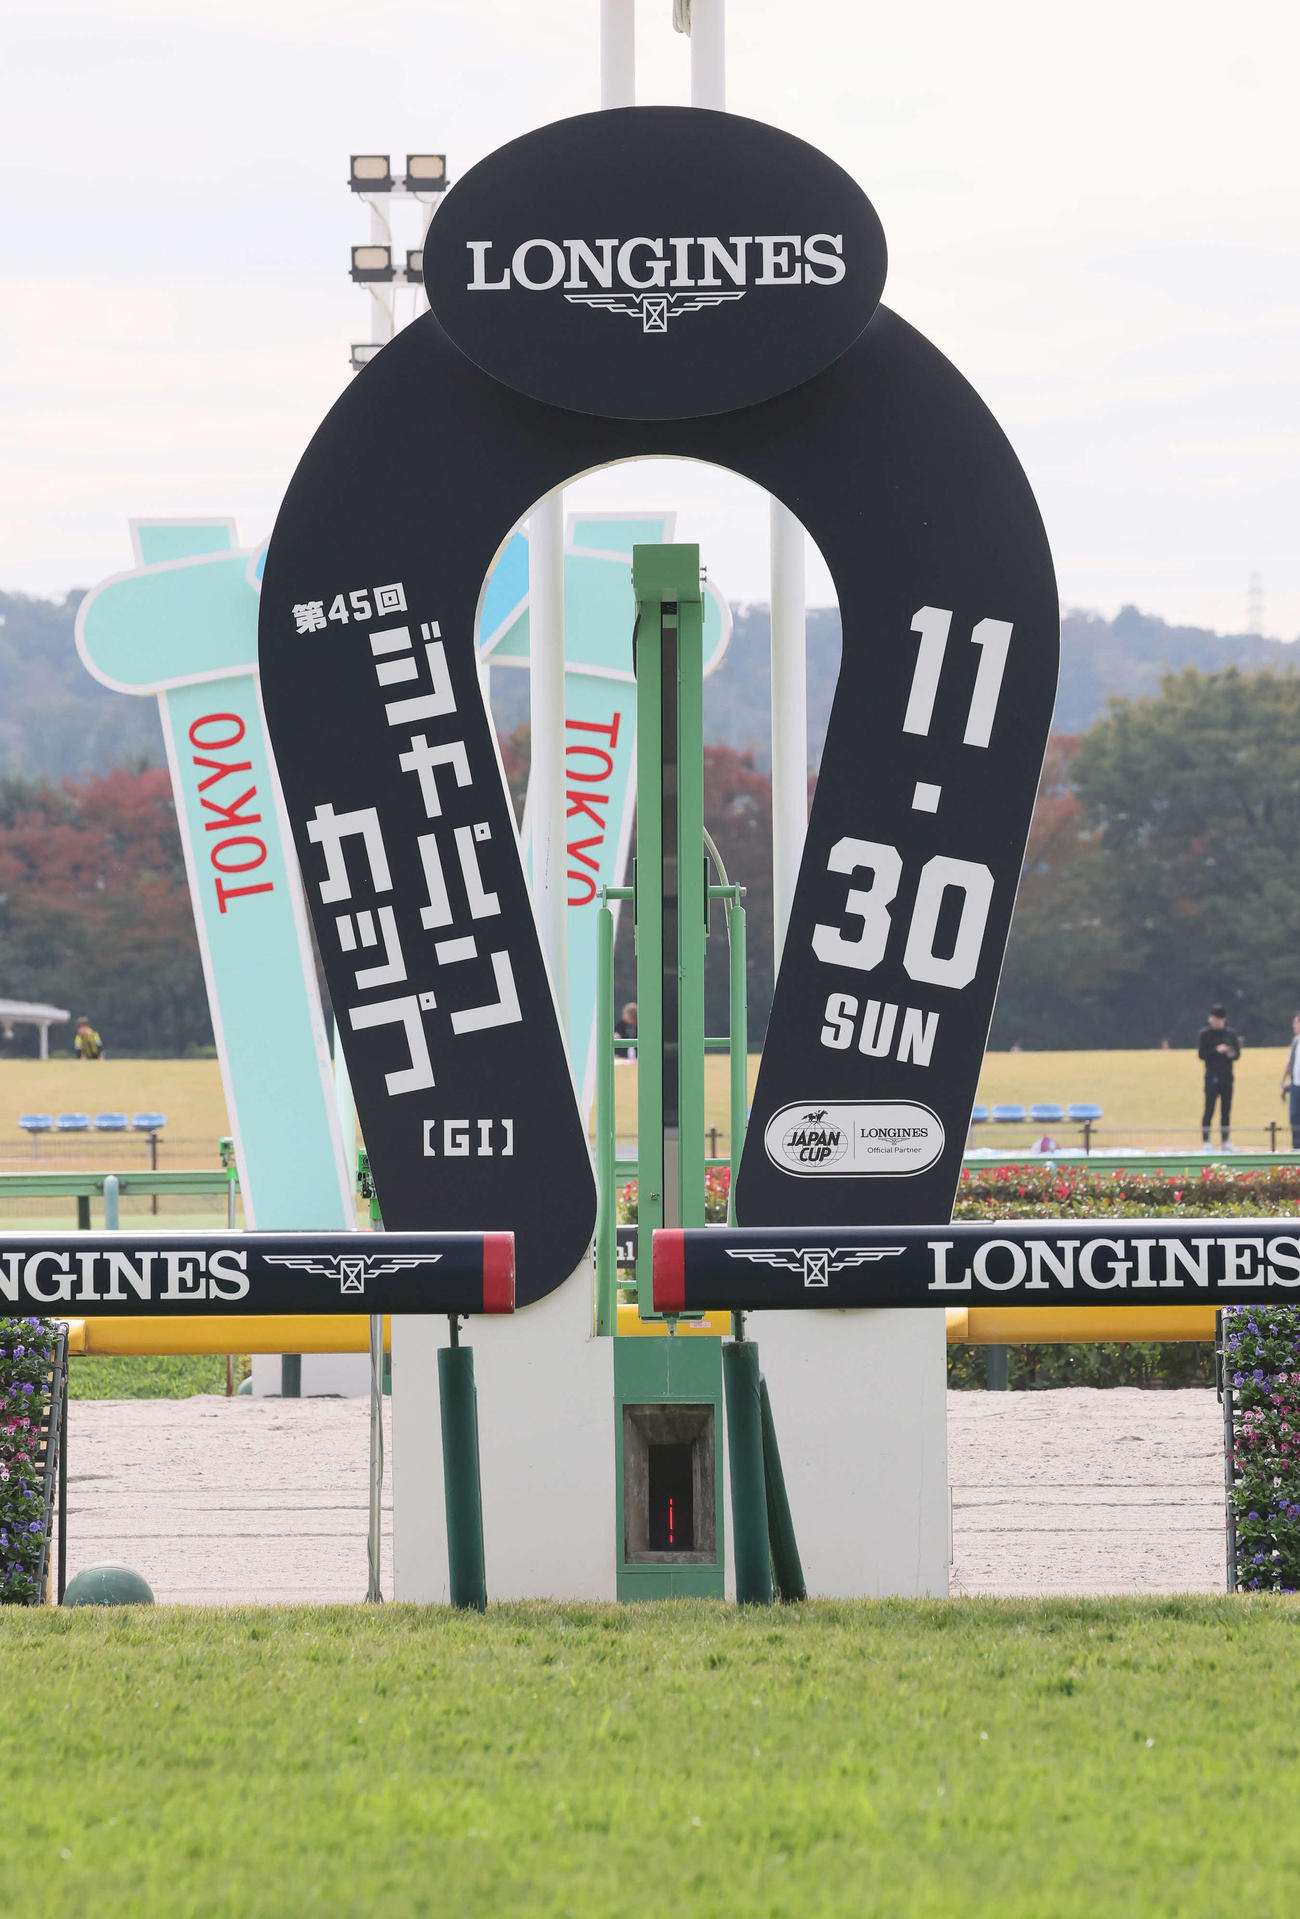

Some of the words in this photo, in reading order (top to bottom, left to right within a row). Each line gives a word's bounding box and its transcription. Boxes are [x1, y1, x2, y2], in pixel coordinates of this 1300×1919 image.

[466, 234, 846, 291] LONGINES
[292, 582, 408, 634] 第45回
[188, 712, 274, 914] TOKYO
[369, 620, 523, 1035] ジャパン
[811, 836, 995, 990] 30
[306, 803, 437, 1096] カップ
[820, 992, 940, 1068] SUN
[786, 1131, 841, 1147] JAPAN
[799, 1147, 832, 1162] CUP
[860, 1127, 929, 1138] LONGINES
[867, 1146, 893, 1154] Official
[894, 1146, 922, 1154] Partner
[927, 1236, 1300, 1291] LONGINES
